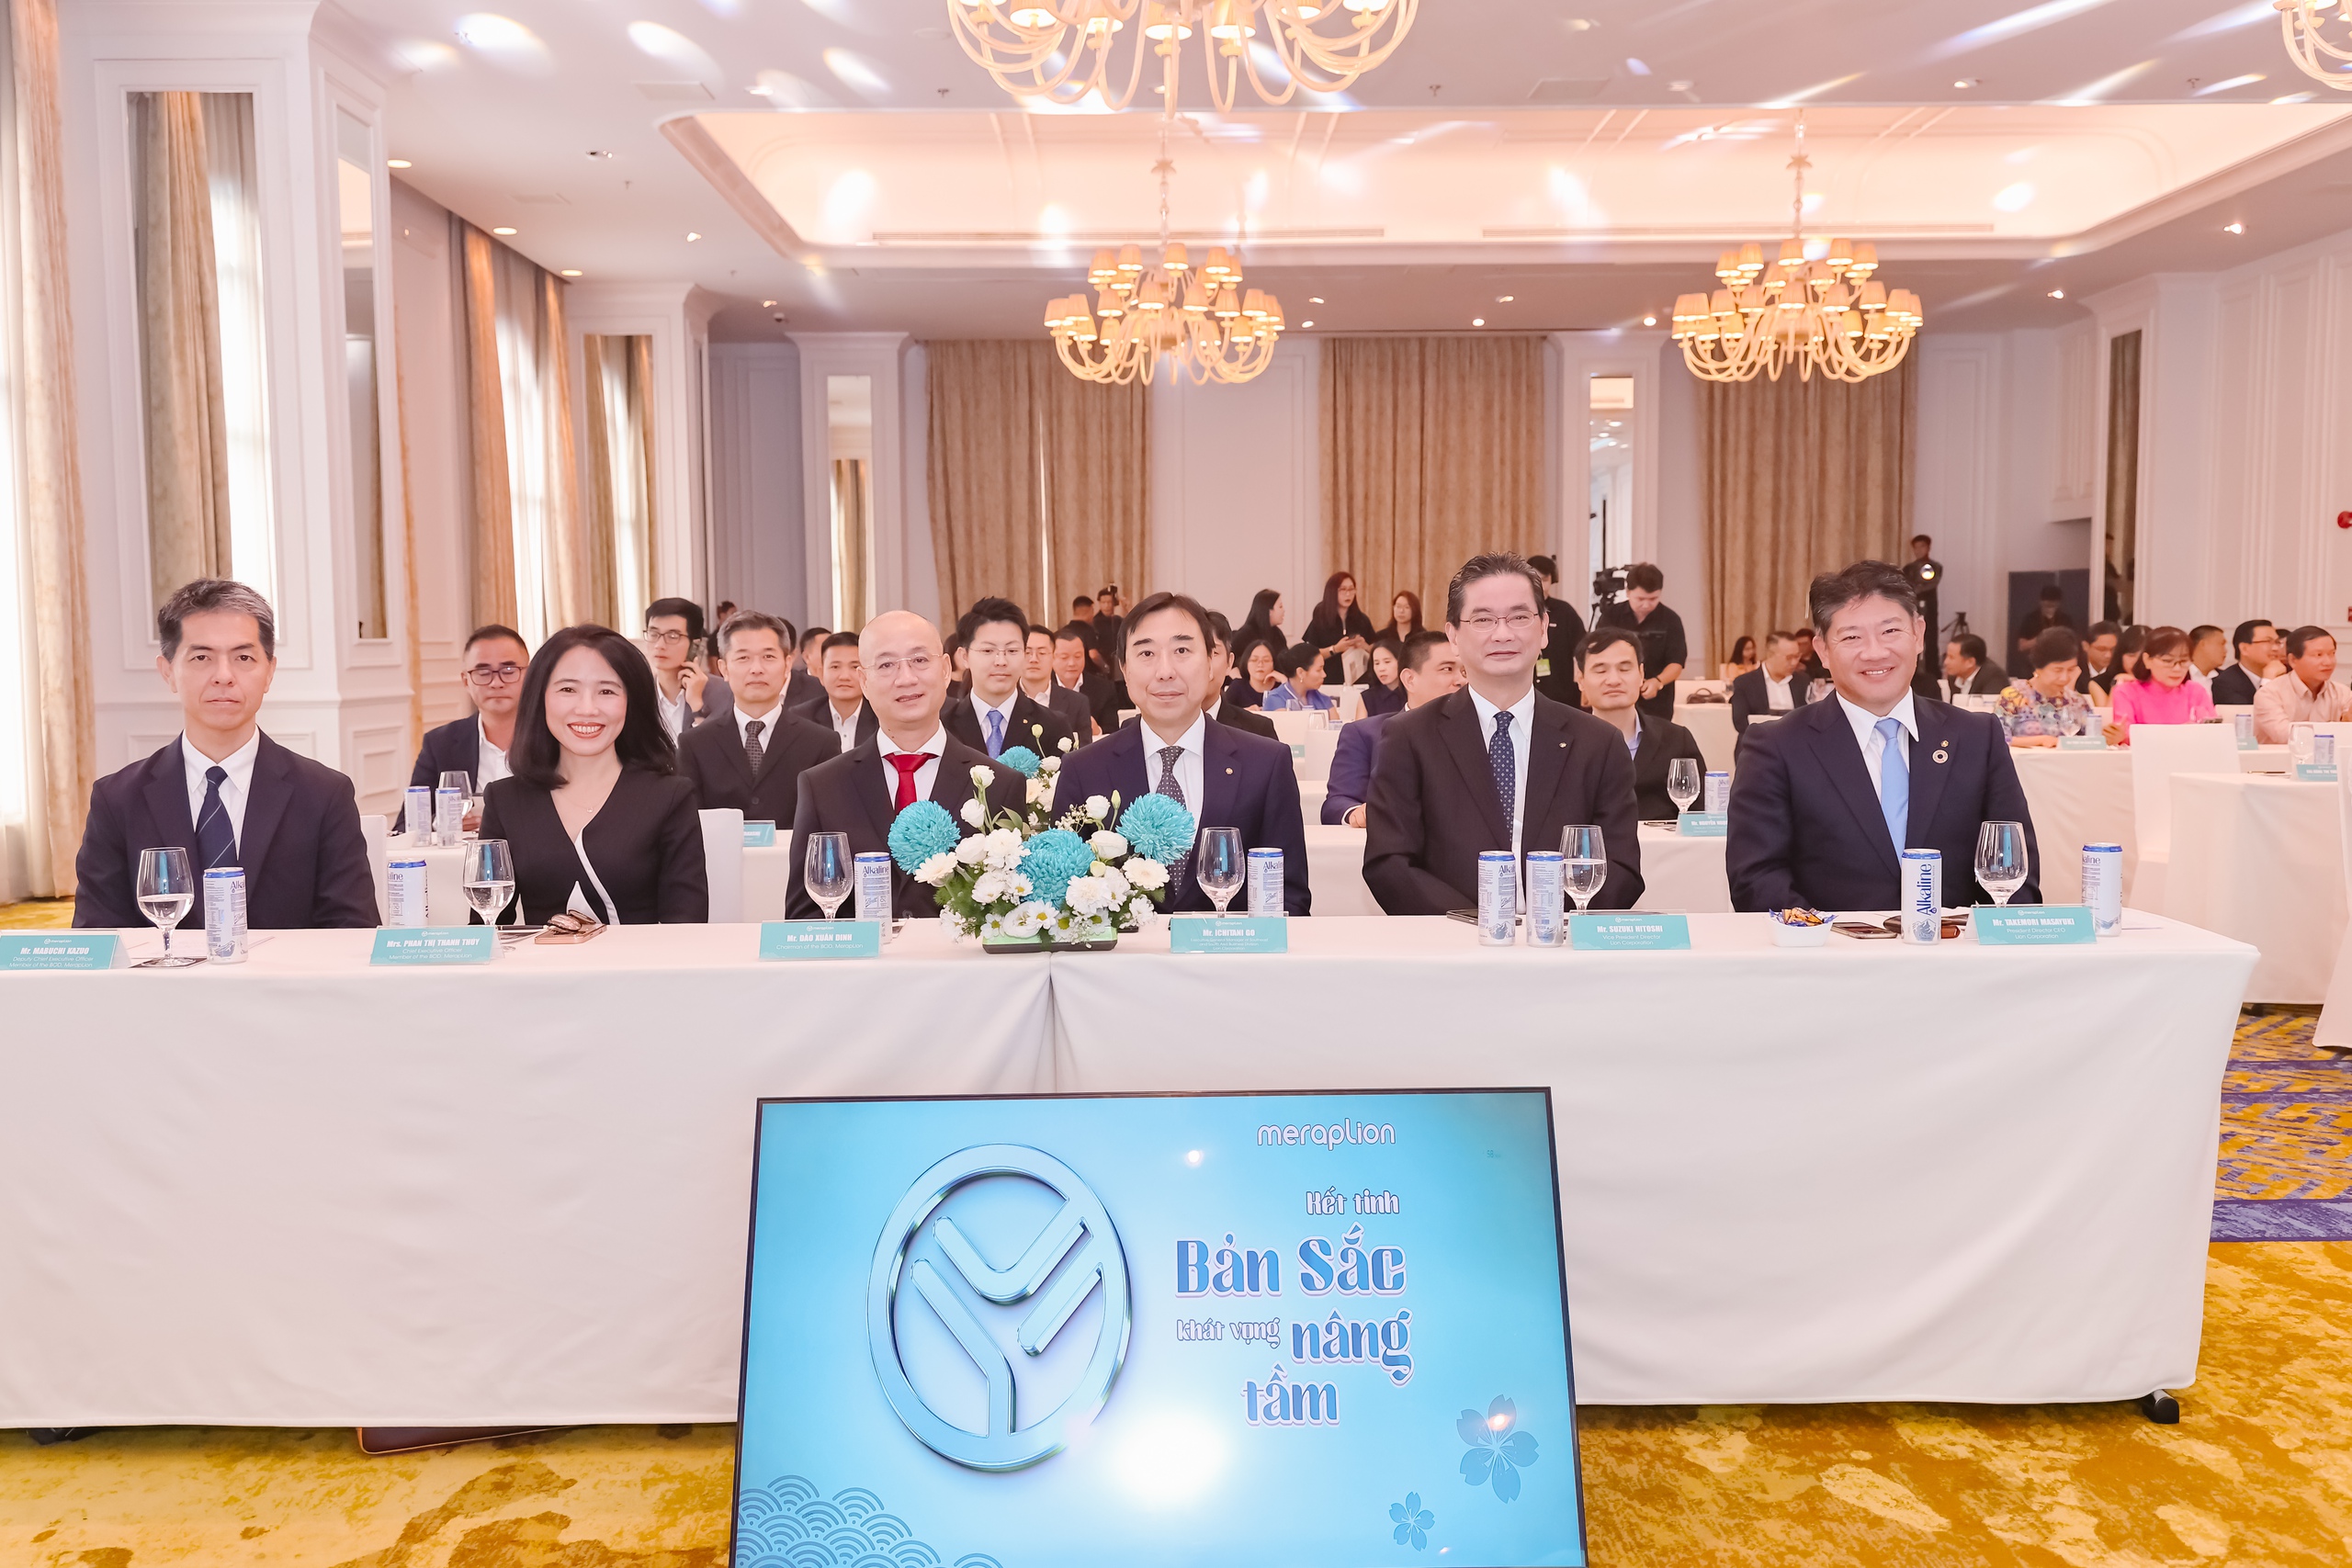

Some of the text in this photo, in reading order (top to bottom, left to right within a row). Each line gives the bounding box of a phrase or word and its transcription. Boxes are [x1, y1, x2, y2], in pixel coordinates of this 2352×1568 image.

[1917, 863, 1932, 916] Alkaline
[33, 947, 65, 955] MABUCHI
[67, 947, 90, 955] KAZUO
[437, 939, 460, 947] THANH
[786, 934, 797, 942] Mr.
[1306, 1186, 1400, 1215] Kết tinh
[1175, 1221, 1408, 1297] Bản Sắc
[1176, 1317, 1281, 1349] khát vọng
[1291, 1308, 1415, 1386] nâng
[1241, 1363, 1340, 1426] tầm
